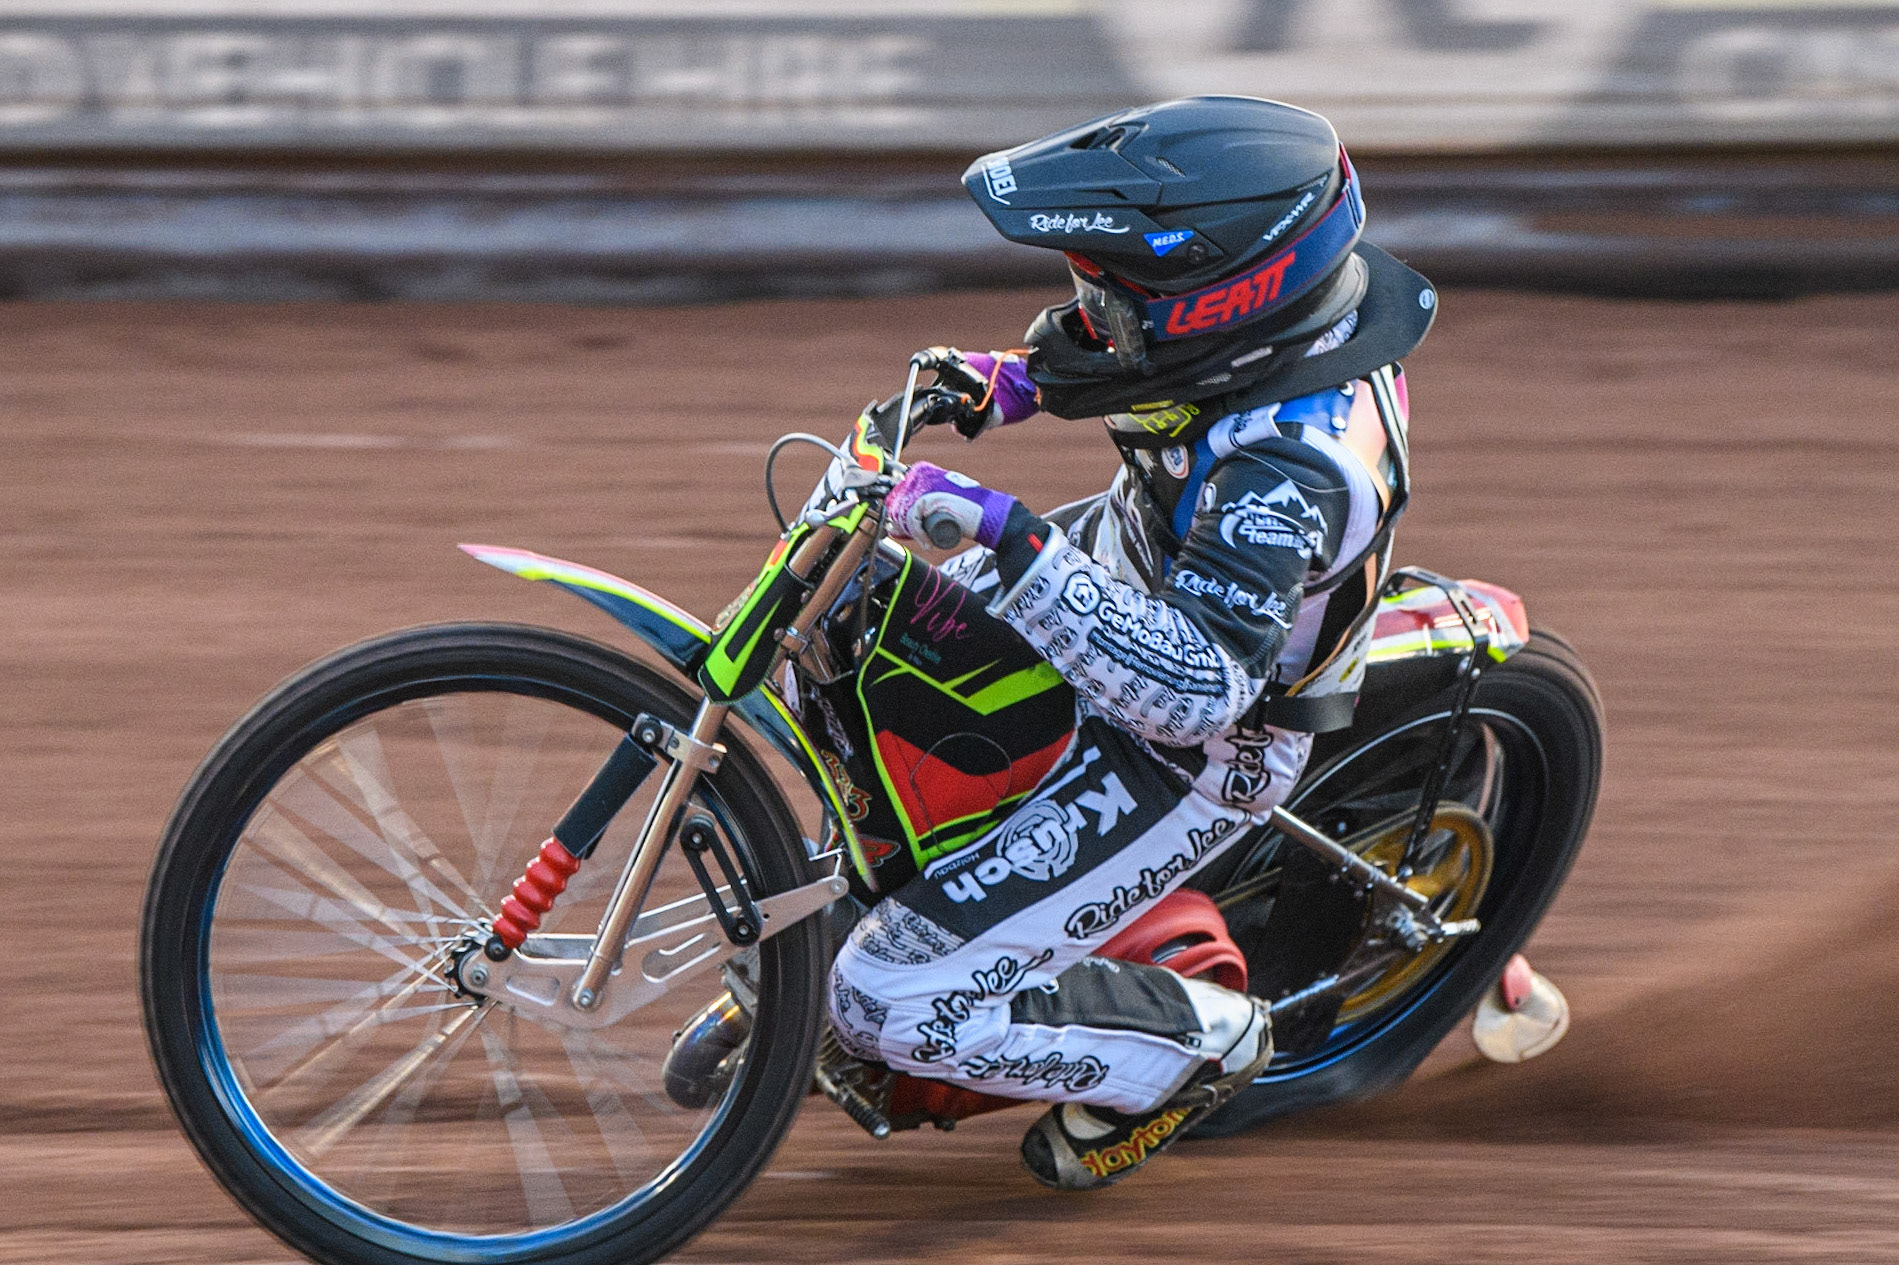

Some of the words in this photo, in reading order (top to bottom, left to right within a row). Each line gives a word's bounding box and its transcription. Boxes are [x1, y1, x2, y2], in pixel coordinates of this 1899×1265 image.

[1030, 213, 1065, 233] Ride
[1063, 213, 1089, 234] for
[1086, 211, 1131, 234] Lee
[1165, 251, 1297, 335] LEATT
[942, 771, 1139, 904] Krusch
[1064, 885, 1146, 940] Ride
[1139, 852, 1188, 899] for
[1184, 811, 1251, 870] Lee
